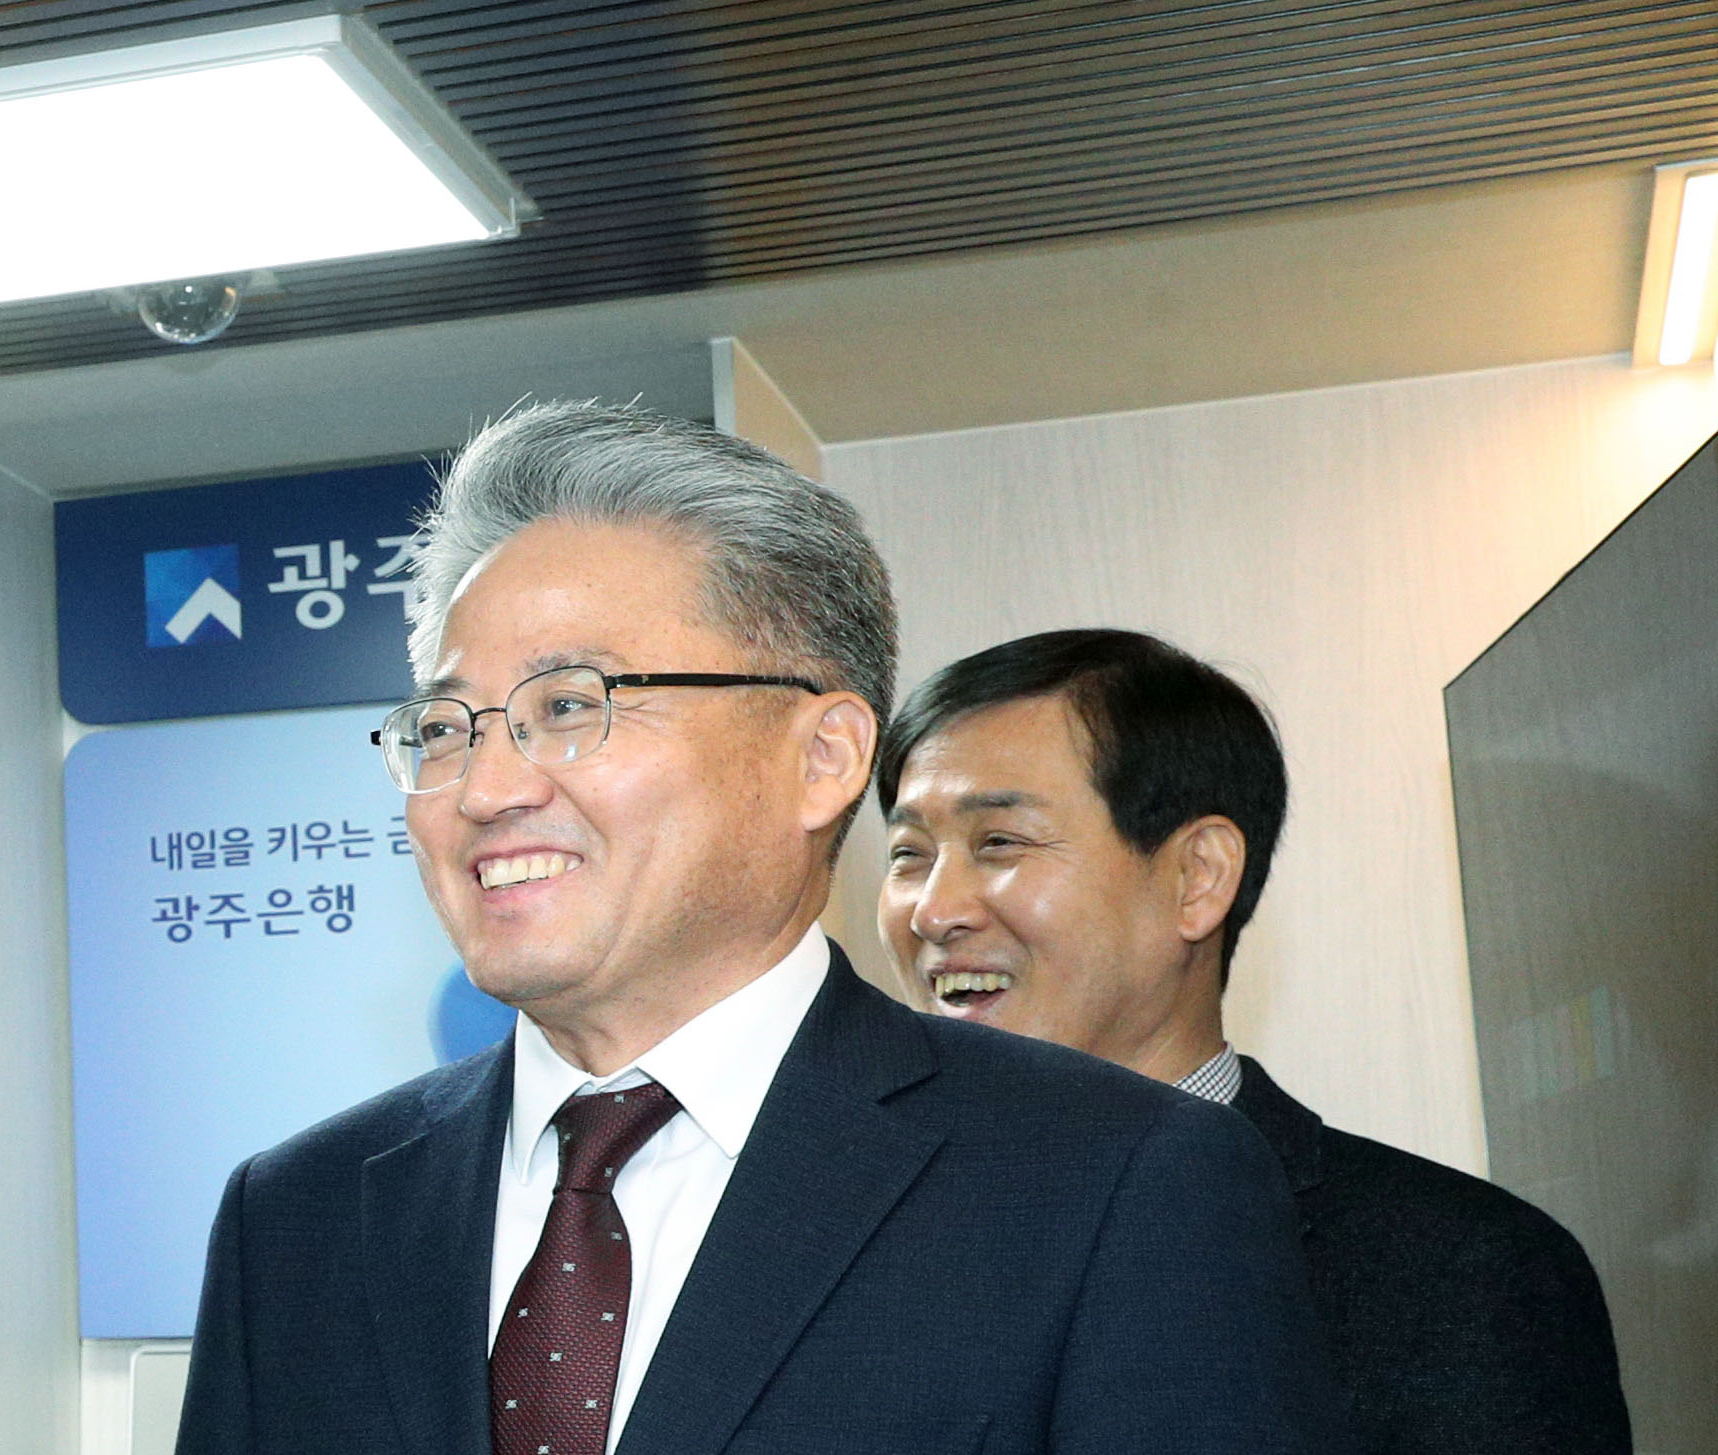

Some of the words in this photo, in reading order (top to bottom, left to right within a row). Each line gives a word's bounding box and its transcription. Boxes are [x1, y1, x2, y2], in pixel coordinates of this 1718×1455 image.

[150, 827, 254, 871] 내일을
[267, 820, 374, 862] 키우는
[151, 884, 355, 943] 광주은행
